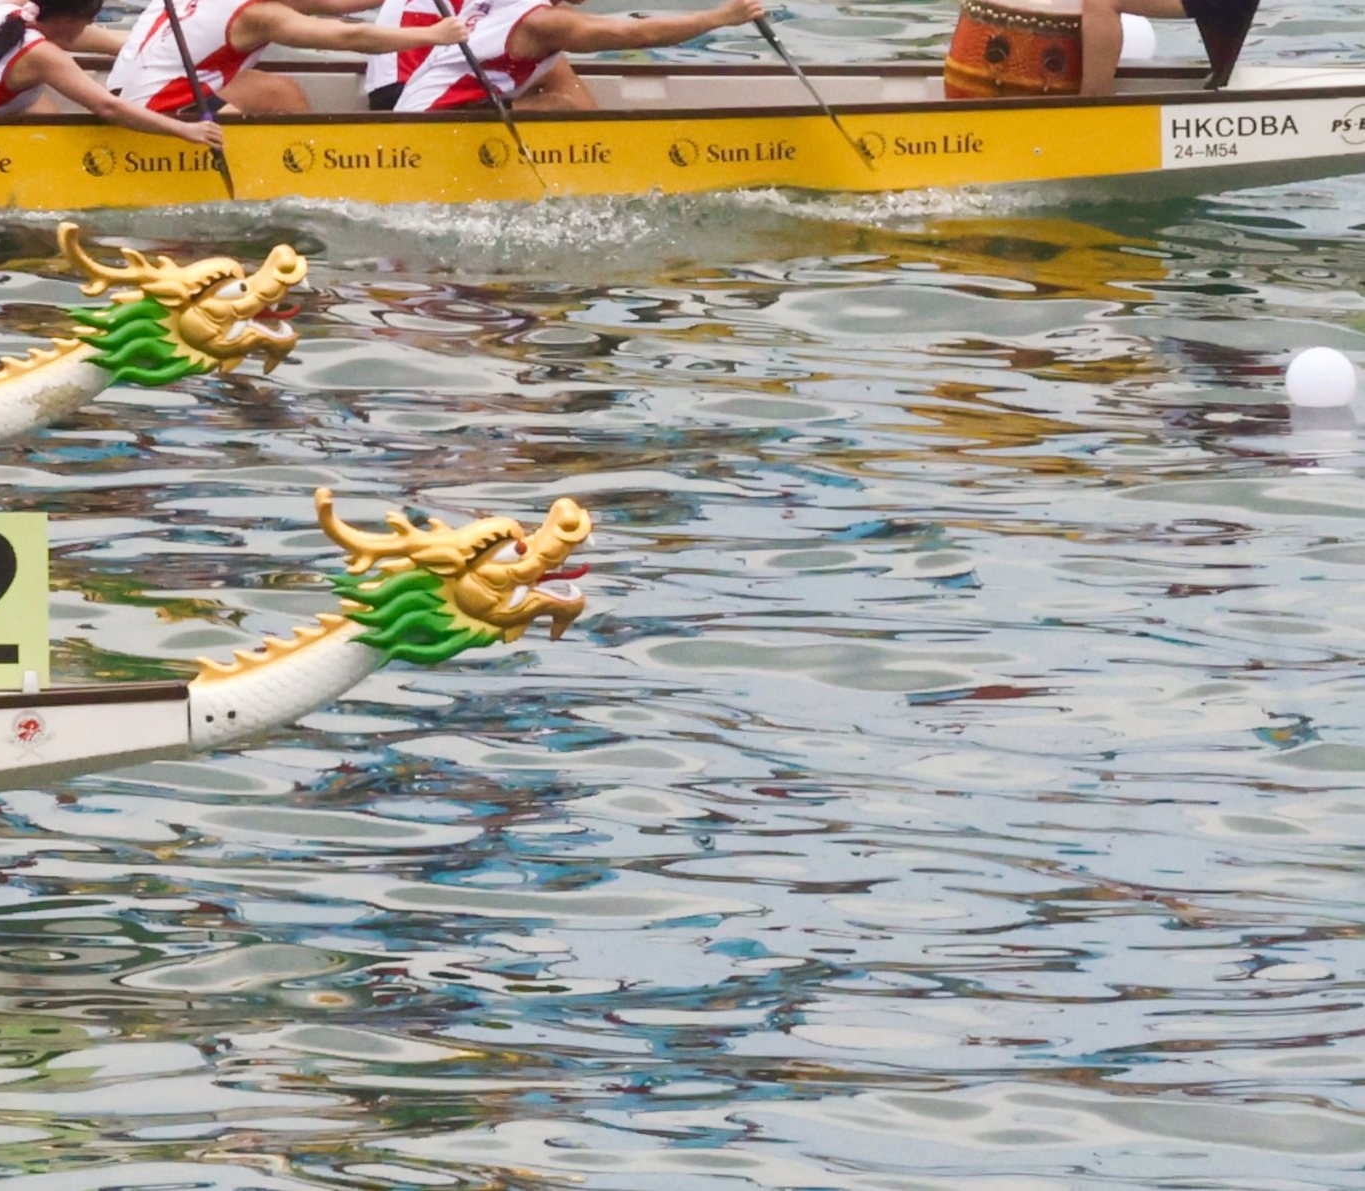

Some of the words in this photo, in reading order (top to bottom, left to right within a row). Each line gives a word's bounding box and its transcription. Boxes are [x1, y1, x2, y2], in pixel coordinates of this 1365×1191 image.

[1172, 115, 1298, 138] HKCDBA
[570, 143, 611, 162] Life
[706, 144, 749, 162] Sun
[757, 144, 796, 160] Life
[894, 137, 936, 155] Sun
[944, 133, 984, 153] Life
[1175, 143, 1238, 158] 24-M54
[125, 152, 172, 172] Sun
[323, 150, 371, 168] Sun
[378, 148, 421, 168] Life
